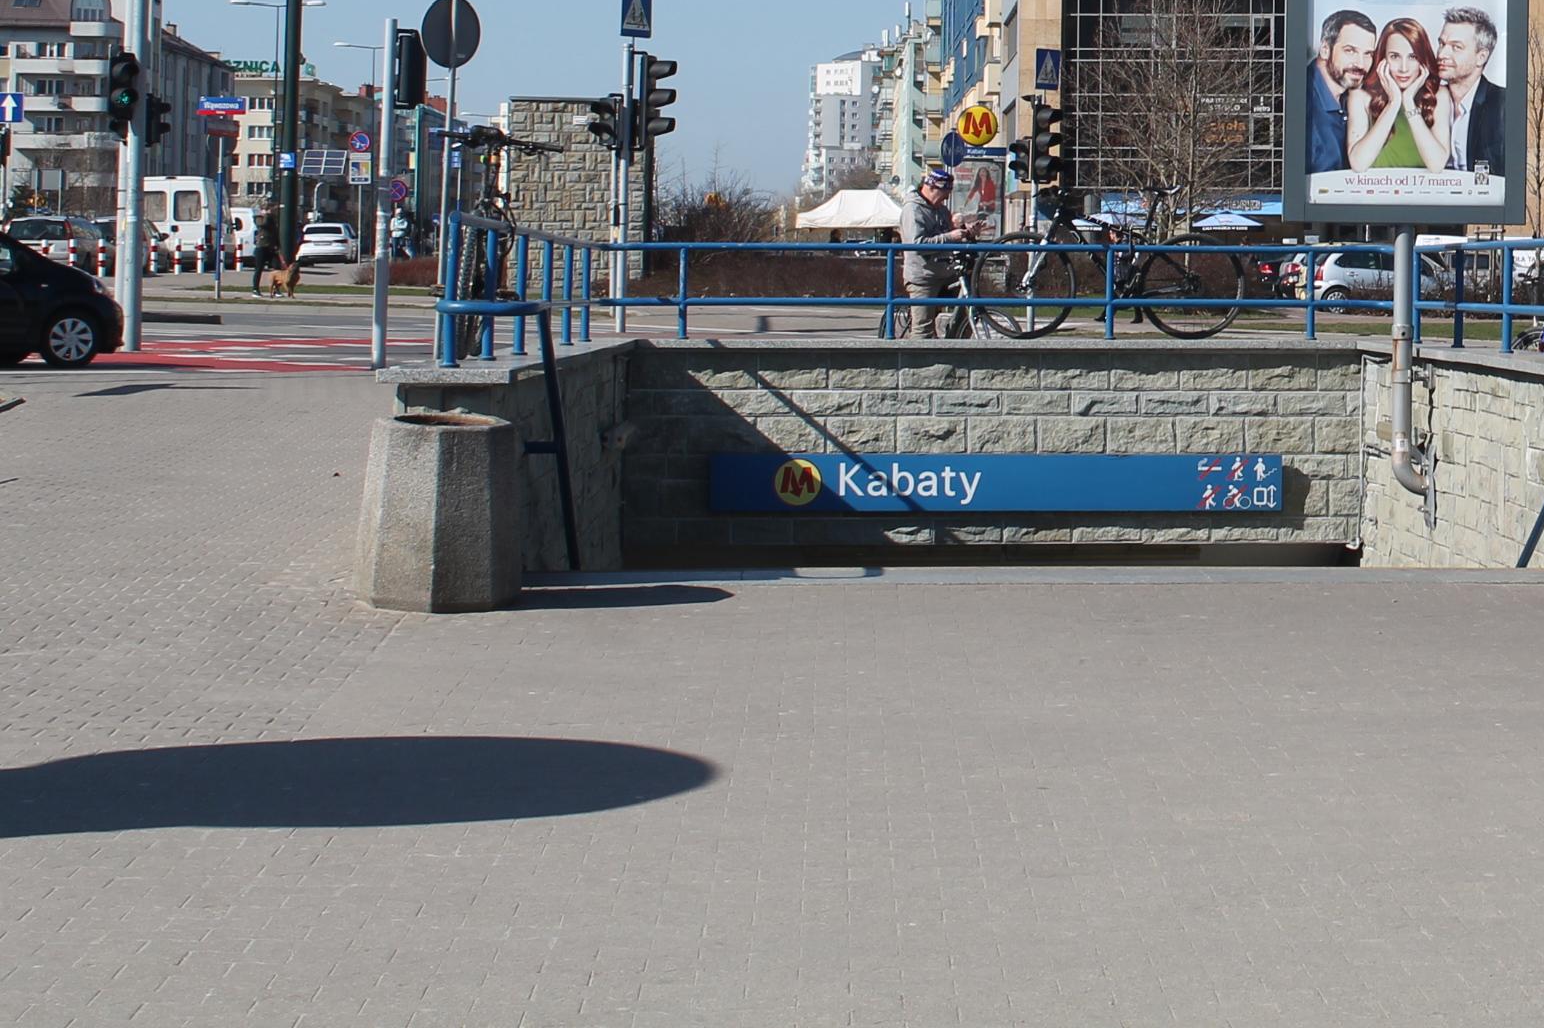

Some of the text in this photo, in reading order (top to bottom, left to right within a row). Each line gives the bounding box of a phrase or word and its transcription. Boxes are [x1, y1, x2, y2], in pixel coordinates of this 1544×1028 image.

[1344, 174, 1462, 187] w kinach od 17 marca
[838, 462, 982, 505] Kabaty
